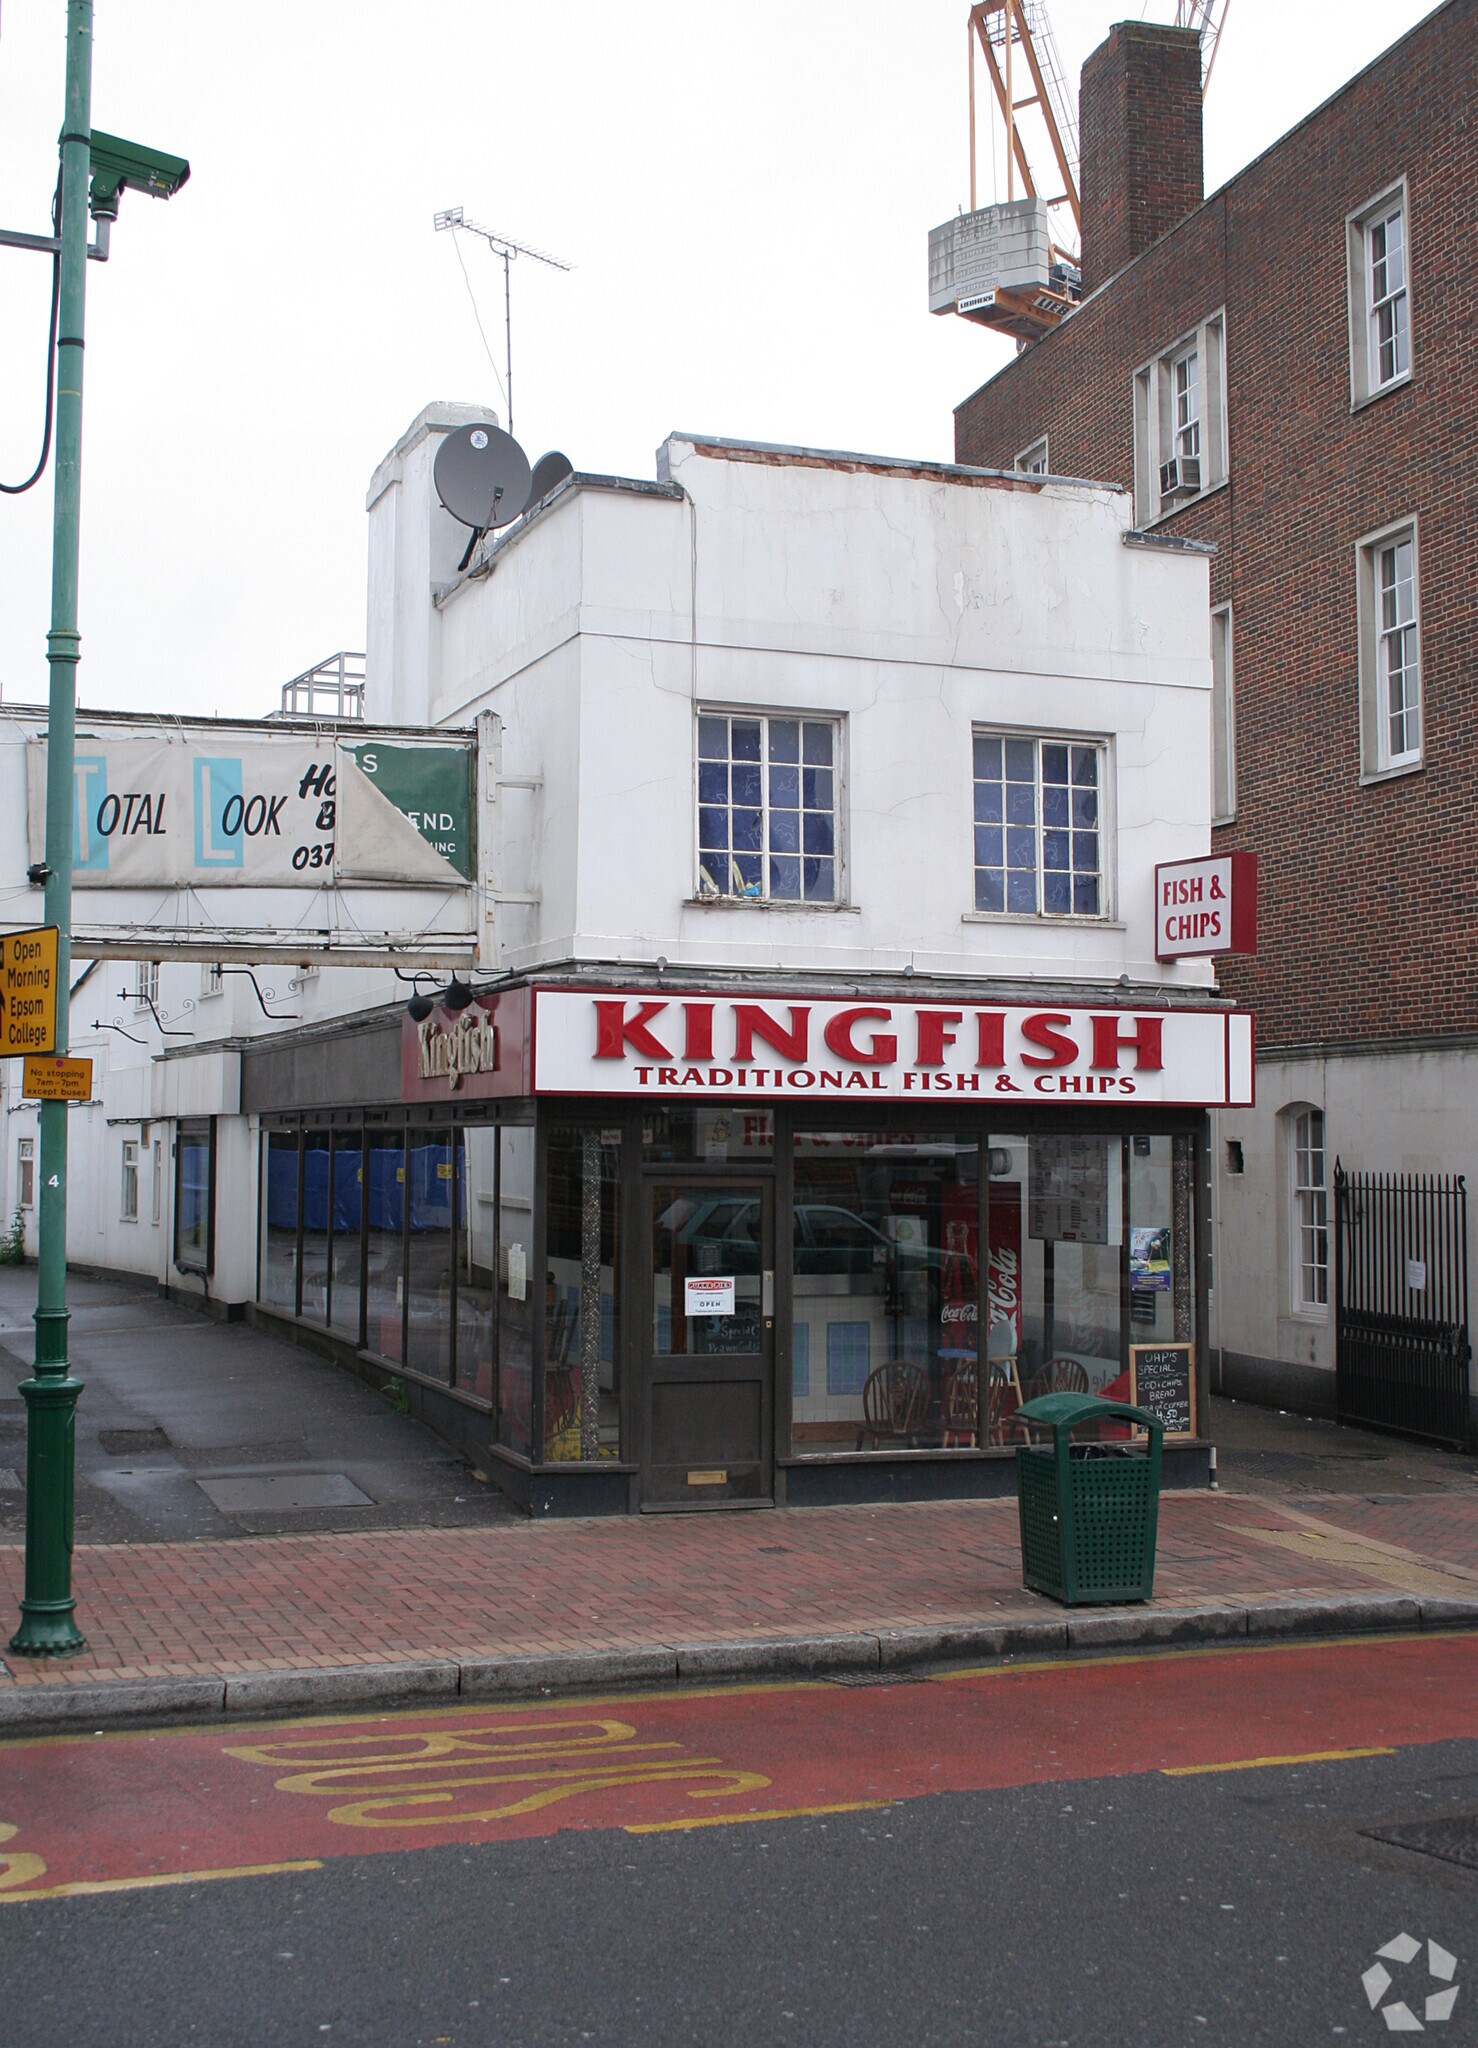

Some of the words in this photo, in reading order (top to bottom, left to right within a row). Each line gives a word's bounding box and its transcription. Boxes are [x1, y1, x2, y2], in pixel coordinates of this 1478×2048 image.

[1163, 876, 1204, 907] FISH
[1209, 874, 1227, 900] &
[1165, 910, 1222, 942] CHIPS
[13, 939, 41, 963] Open
[7, 967, 50, 989] Morning
[10, 997, 44, 1020] Epsom
[8, 1024, 47, 1046] College
[591, 1000, 1165, 1071] KINGFISH
[417, 1009, 495, 1090] Kingfish
[30, 1068, 43, 1077] No
[46, 1069, 85, 1080] stopping
[633, 1066, 888, 1089] TRADITIONAL
[903, 1072, 980, 1091] FISH
[994, 1074, 1025, 1092] &
[1033, 1075, 1136, 1094] CHIPS
[26, 1088, 57, 1097] except
[60, 1087, 87, 1097] buses
[48, 1173, 61, 1188] 4
[720, 1325, 756, 1340] Special
[1138, 1363, 1176, 1376] SPECIAL
[1148, 1389, 1176, 1402] BREAD
[1156, 1409, 1178, 1420] 4.50
